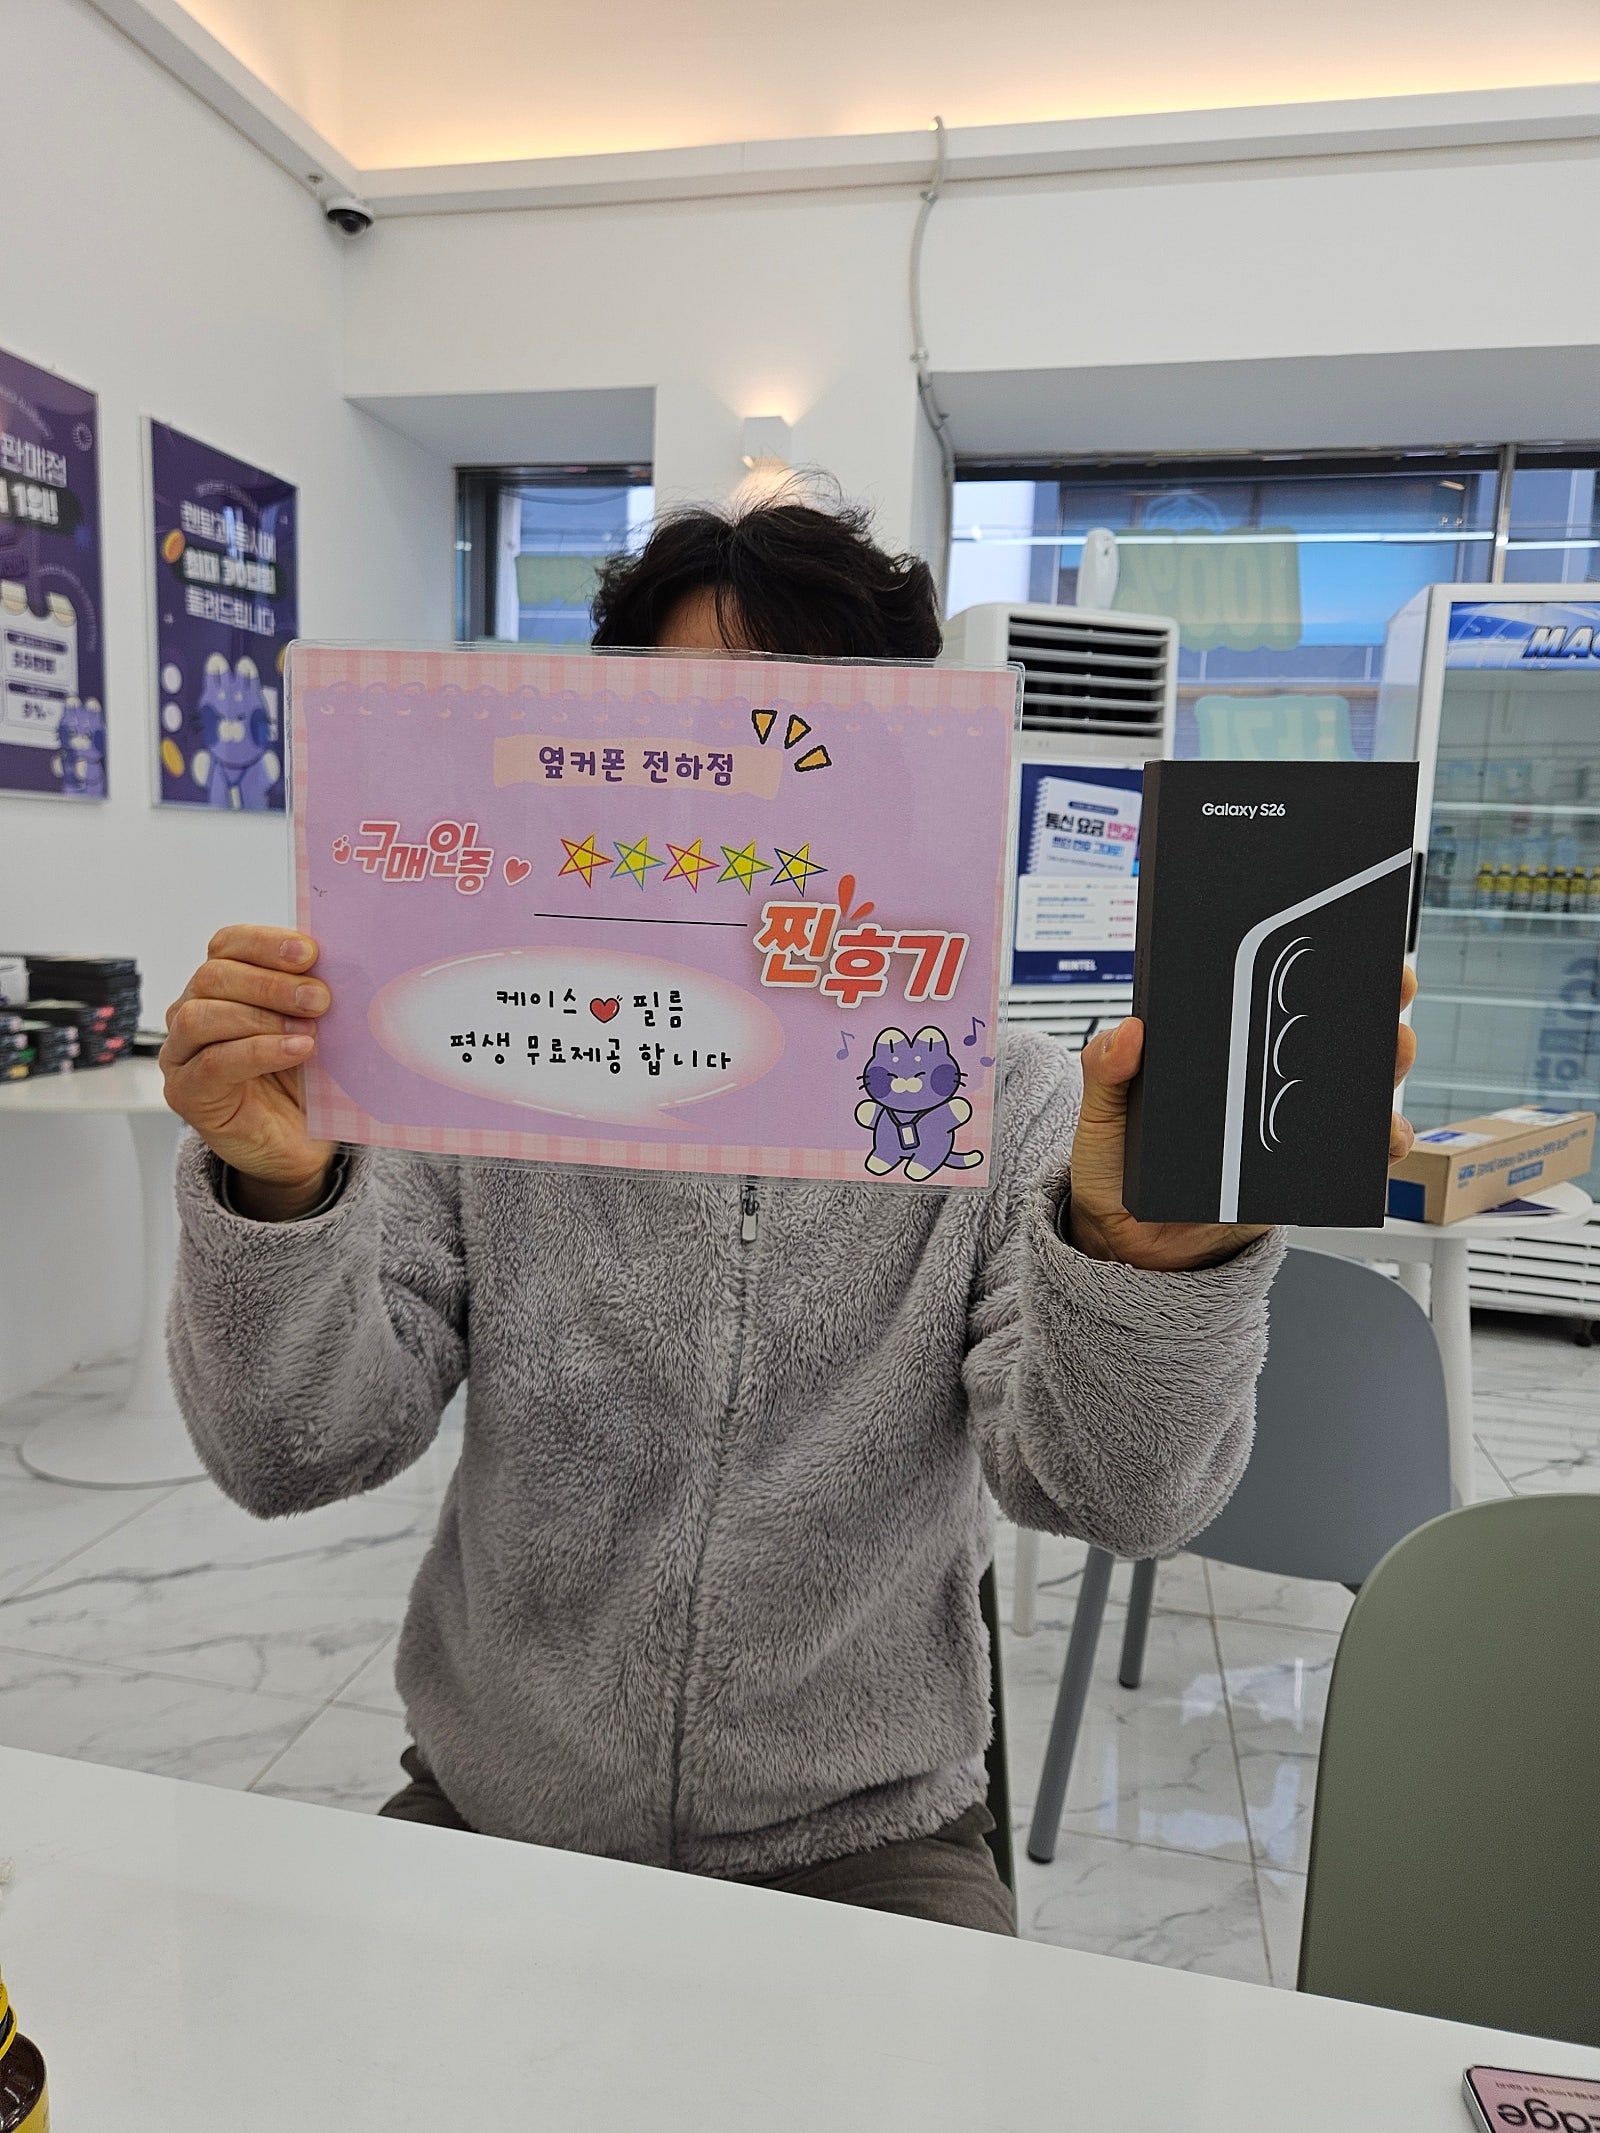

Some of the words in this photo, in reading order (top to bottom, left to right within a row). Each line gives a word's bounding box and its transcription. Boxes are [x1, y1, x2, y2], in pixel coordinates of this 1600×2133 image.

[1521, 625, 1600, 660] MA
[538, 745, 625, 781] 옆커폰
[642, 749, 735, 785] 전하점
[1046, 812, 1074, 832] 통신
[1077, 817, 1105, 837] 요금
[1202, 802, 1258, 820] Galaxy
[1260, 803, 1286, 816] S26
[353, 820, 495, 894] 구매인증
[753, 901, 970, 1008] 찐후기
[495, 987, 578, 1015] 케이스
[632, 988, 685, 1030] 필름
[450, 1030, 512, 1065] 평생
[525, 1036, 622, 1075] 무료제공
[638, 1043, 732, 1076] 합니다
